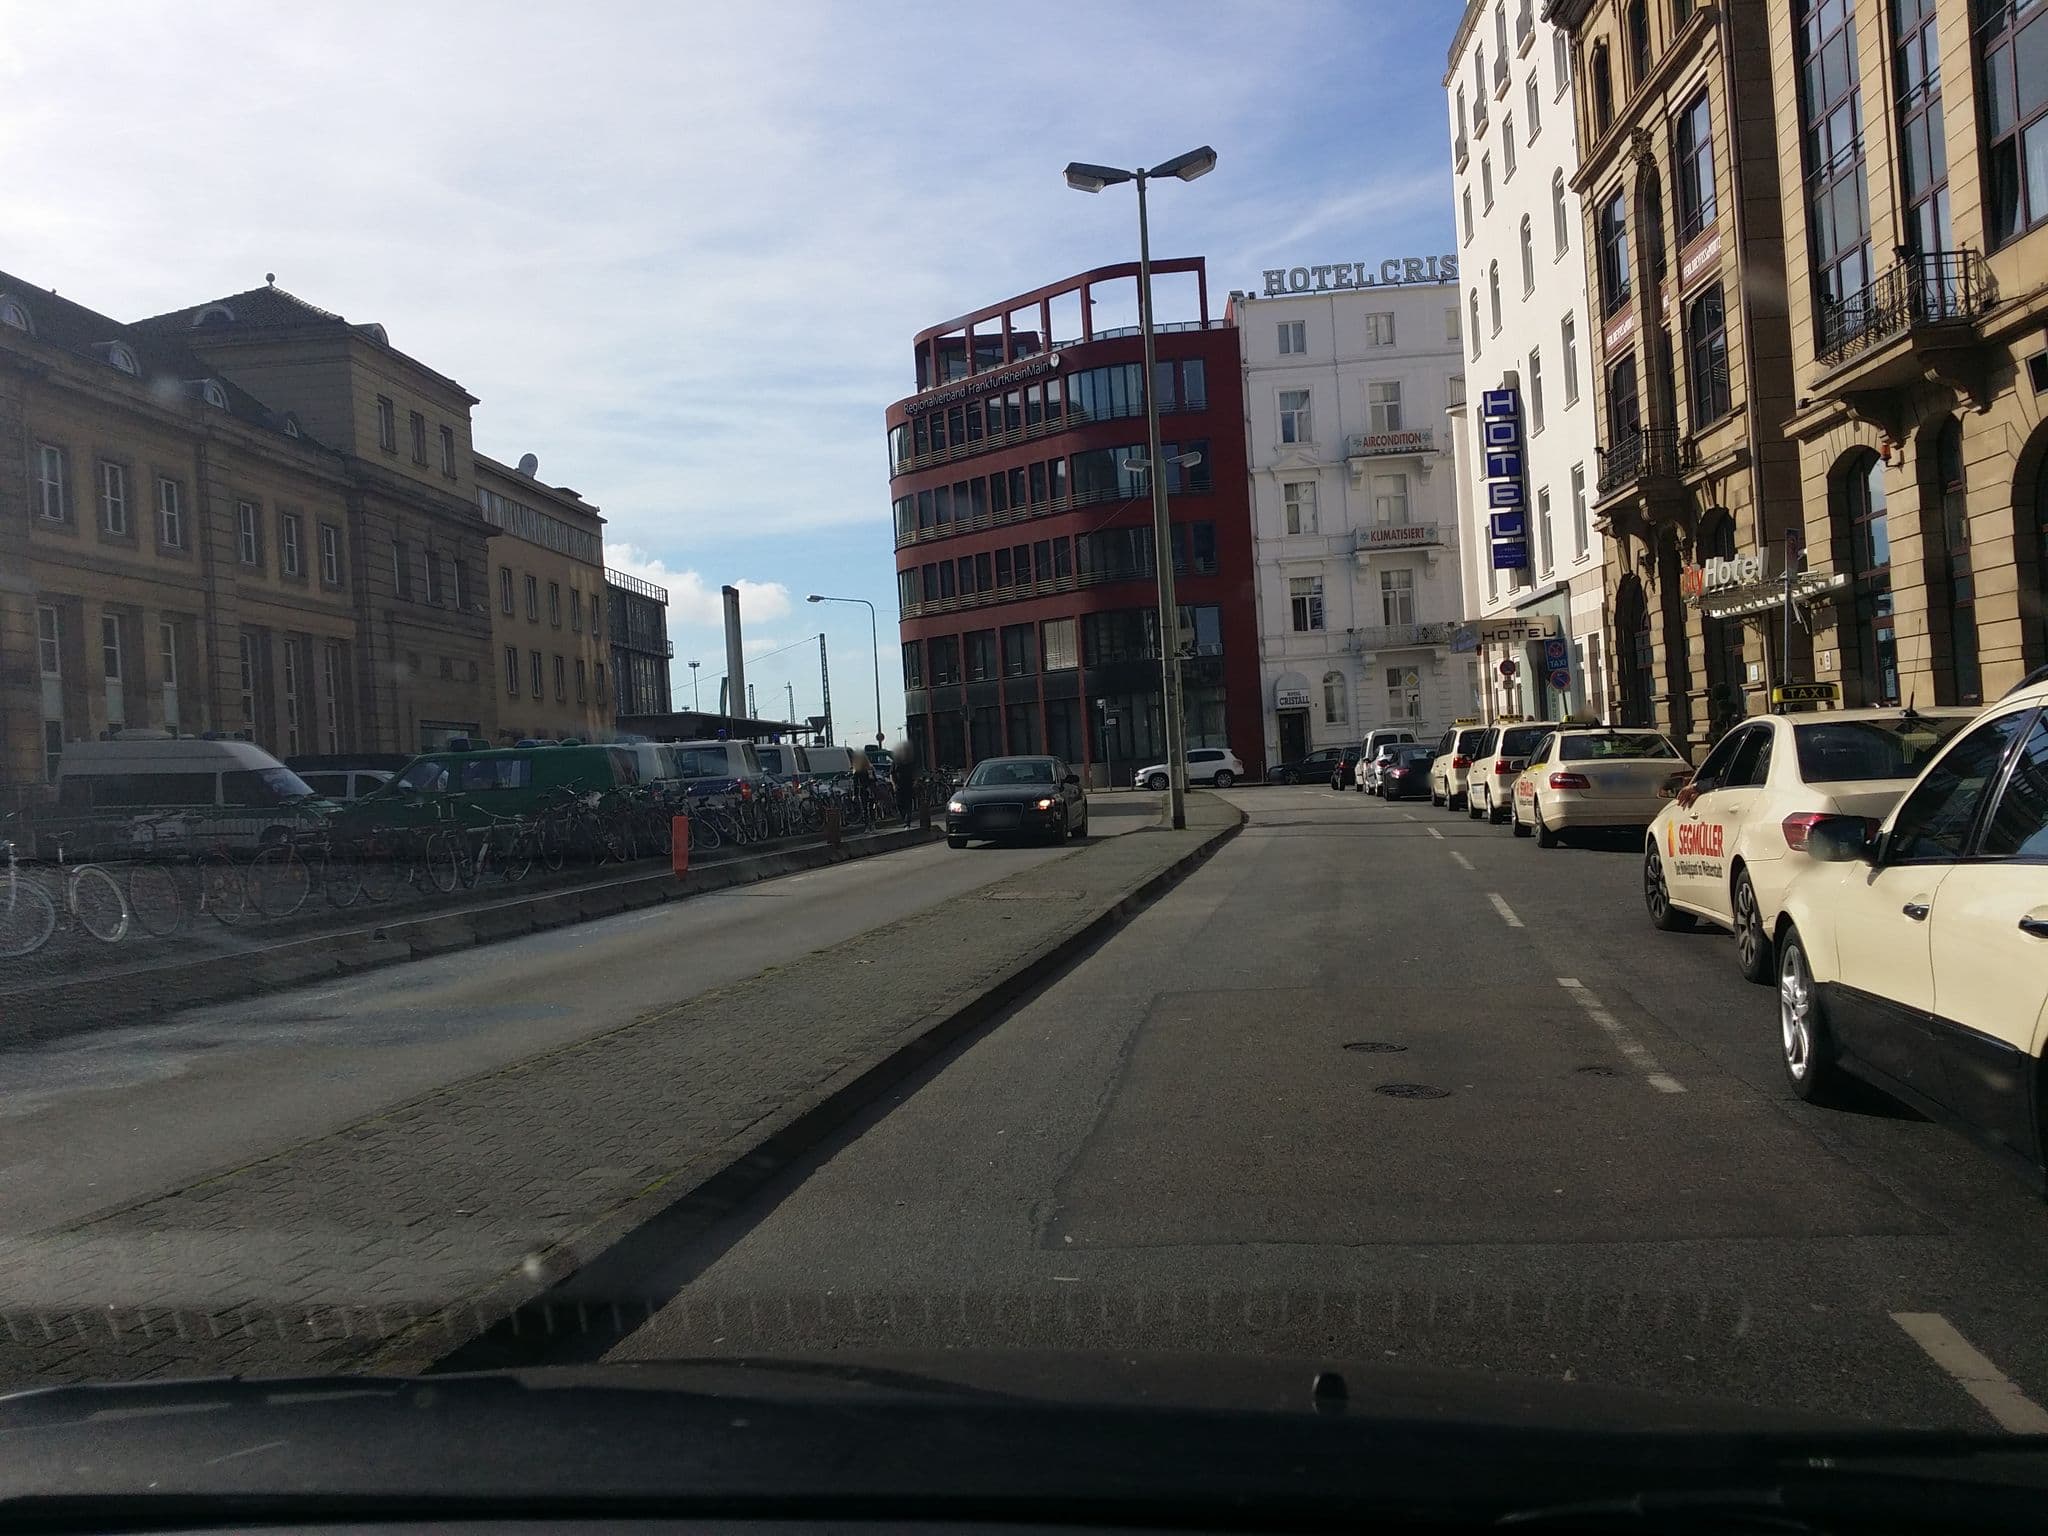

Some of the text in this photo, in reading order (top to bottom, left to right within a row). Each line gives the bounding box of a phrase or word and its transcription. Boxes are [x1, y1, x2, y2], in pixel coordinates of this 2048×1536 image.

[1263, 254, 1458, 295] HOTEL CRIS
[1363, 433, 1422, 448] AIRCONDITION
[1487, 393, 1520, 535] HOTEL
[1370, 527, 1425, 542] KLIMATISIERT
[1482, 627, 1556, 642] HOTEL
[1549, 659, 1567, 668] TAXI
[1280, 696, 1310, 705] CRISTALL
[1788, 687, 1826, 699] TAXI
[1679, 821, 1725, 858] SEGMÜLLER
